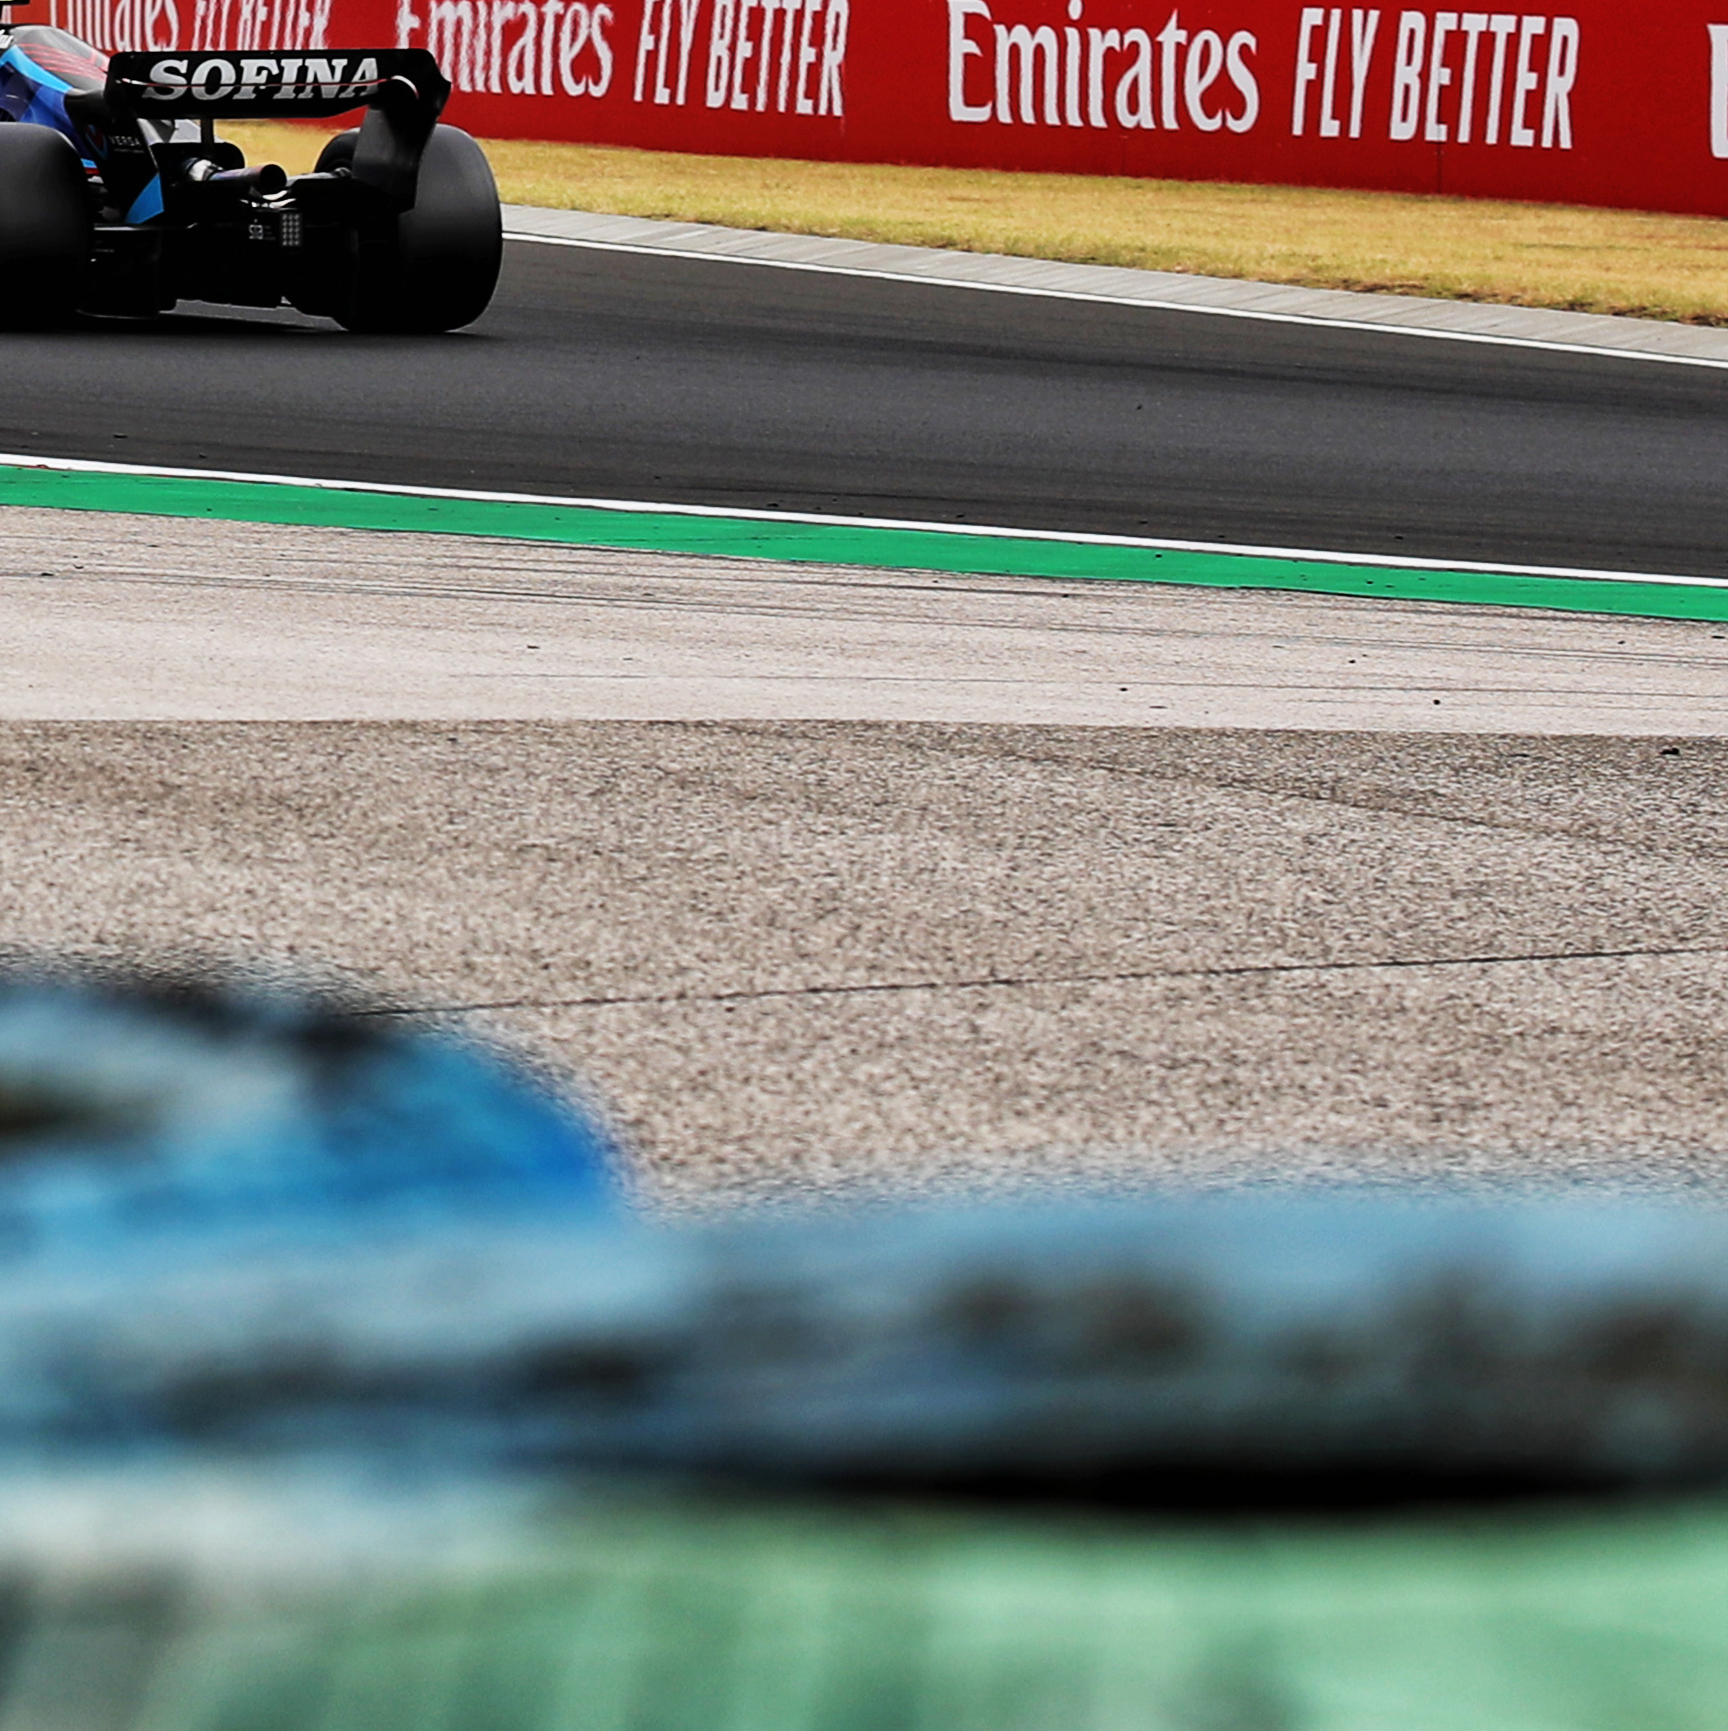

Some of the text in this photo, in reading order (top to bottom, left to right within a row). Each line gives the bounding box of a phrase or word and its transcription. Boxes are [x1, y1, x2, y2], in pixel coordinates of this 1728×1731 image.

[141, 57, 379, 101] SOFINA
[1292, 7, 1380, 138] FLY
[1390, 10, 1579, 149] BETTER
